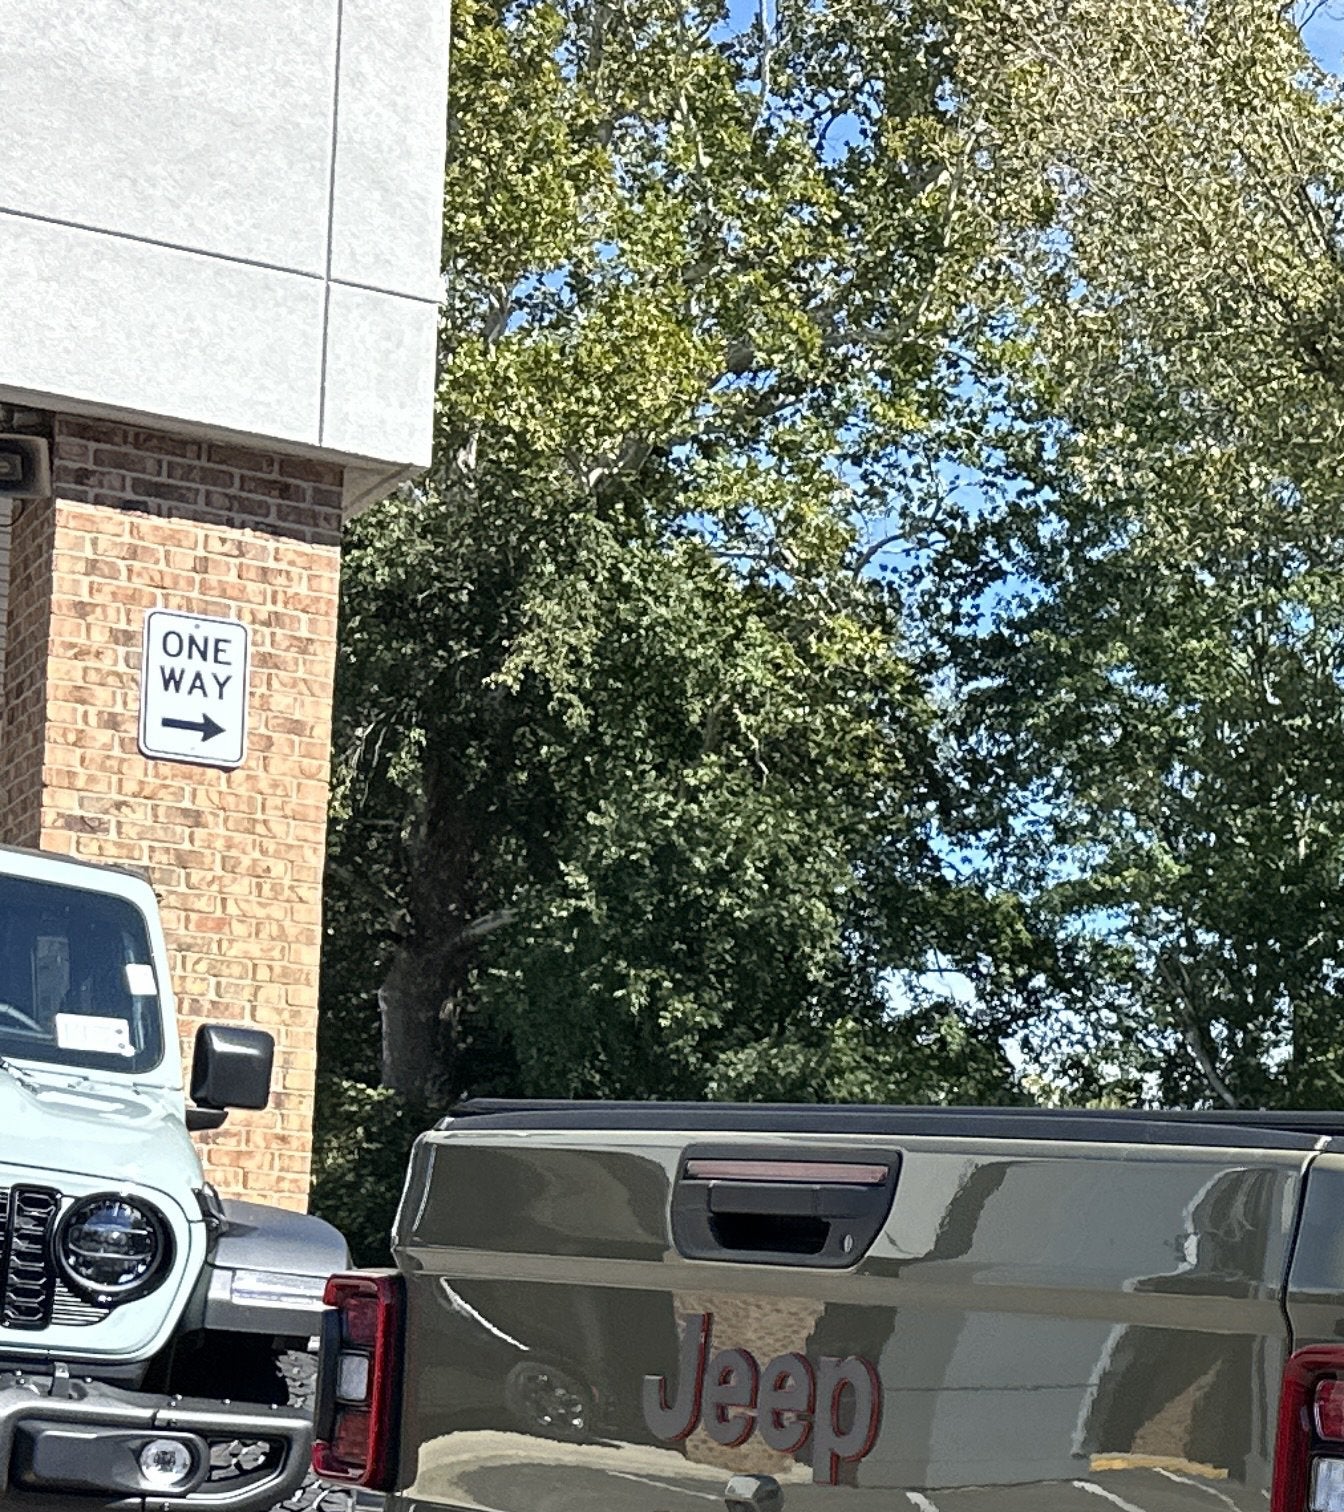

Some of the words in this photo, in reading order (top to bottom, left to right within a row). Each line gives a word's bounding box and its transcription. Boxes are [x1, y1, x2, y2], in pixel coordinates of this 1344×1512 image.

[162, 630, 232, 666] ONE
[160, 665, 232, 700] WAY
[642, 1312, 884, 1487] Jeep
